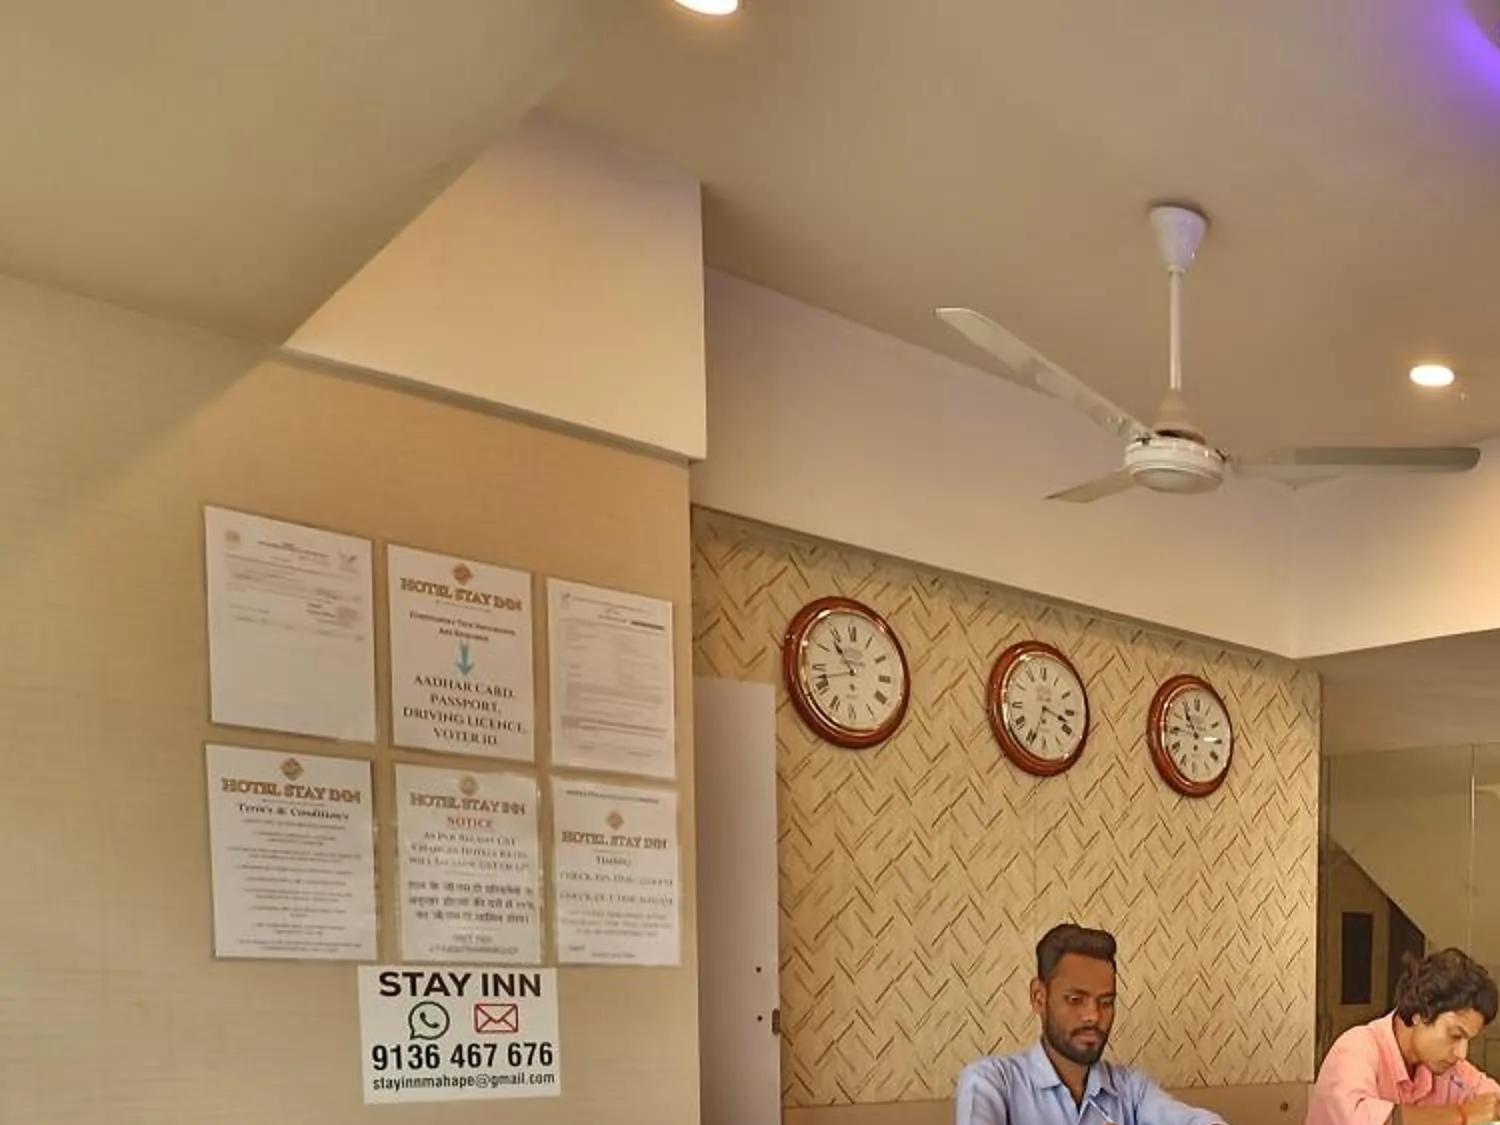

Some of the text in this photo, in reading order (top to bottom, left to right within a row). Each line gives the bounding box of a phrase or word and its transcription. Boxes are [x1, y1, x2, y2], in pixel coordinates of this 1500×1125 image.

[400, 577, 452, 599] HOTEL
[455, 587, 493, 606] STAY
[415, 674, 473, 693] AADHAR
[403, 706, 464, 724] DRIVING
[433, 727, 480, 743] VOTER
[221, 777, 282, 797] HOTEL
[284, 784, 328, 800] STAY
[409, 791, 460, 809] HOTEL
[461, 797, 500, 813] STAY
[561, 830, 608, 846] HOTEL
[611, 834, 643, 848] STAY
[378, 971, 541, 997] STAY INN
[371, 1041, 553, 1071] 9136 467 676
[373, 1072, 555, 1093] stayinnmahape@gmail.com
